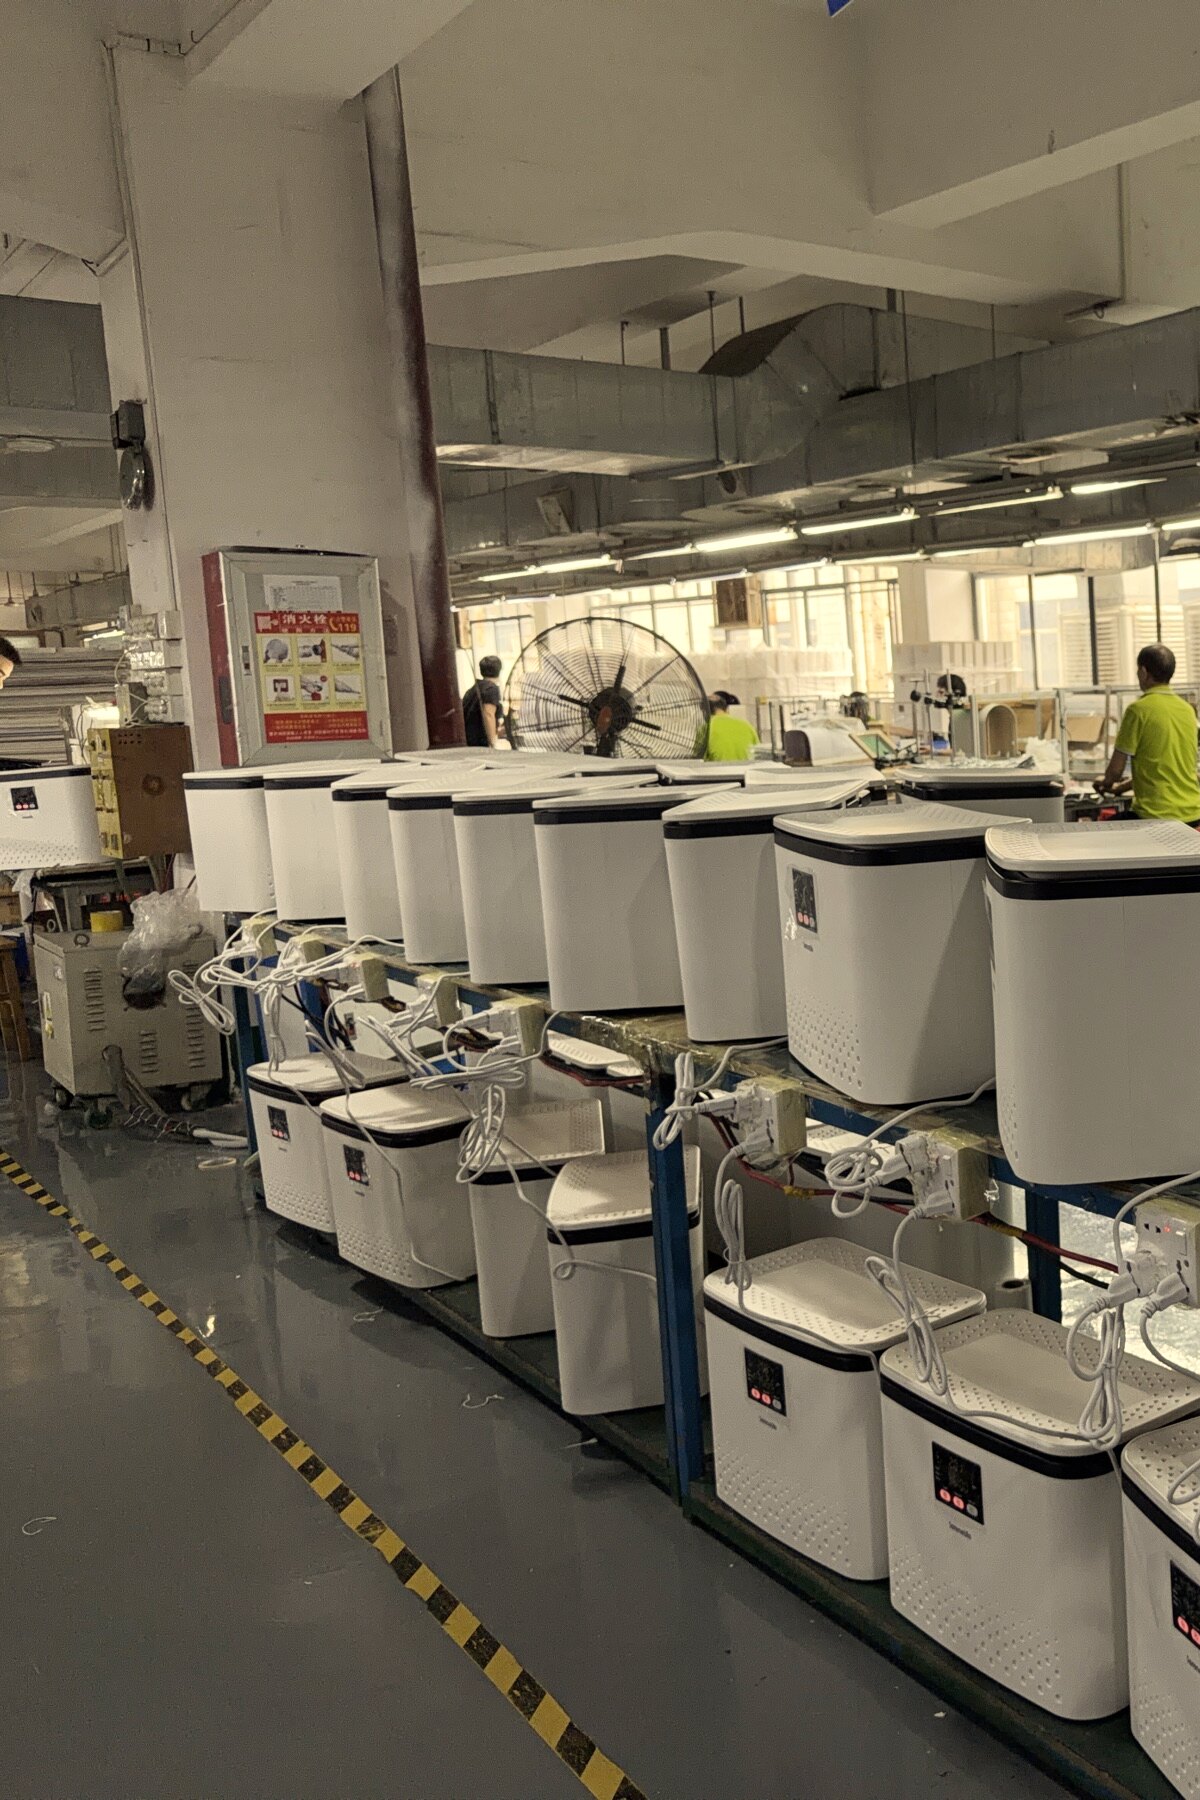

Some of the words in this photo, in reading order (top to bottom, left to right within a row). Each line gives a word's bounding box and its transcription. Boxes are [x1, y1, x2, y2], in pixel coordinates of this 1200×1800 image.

[282, 614, 327, 625] 消火栓
[339, 623, 357, 632] 119
